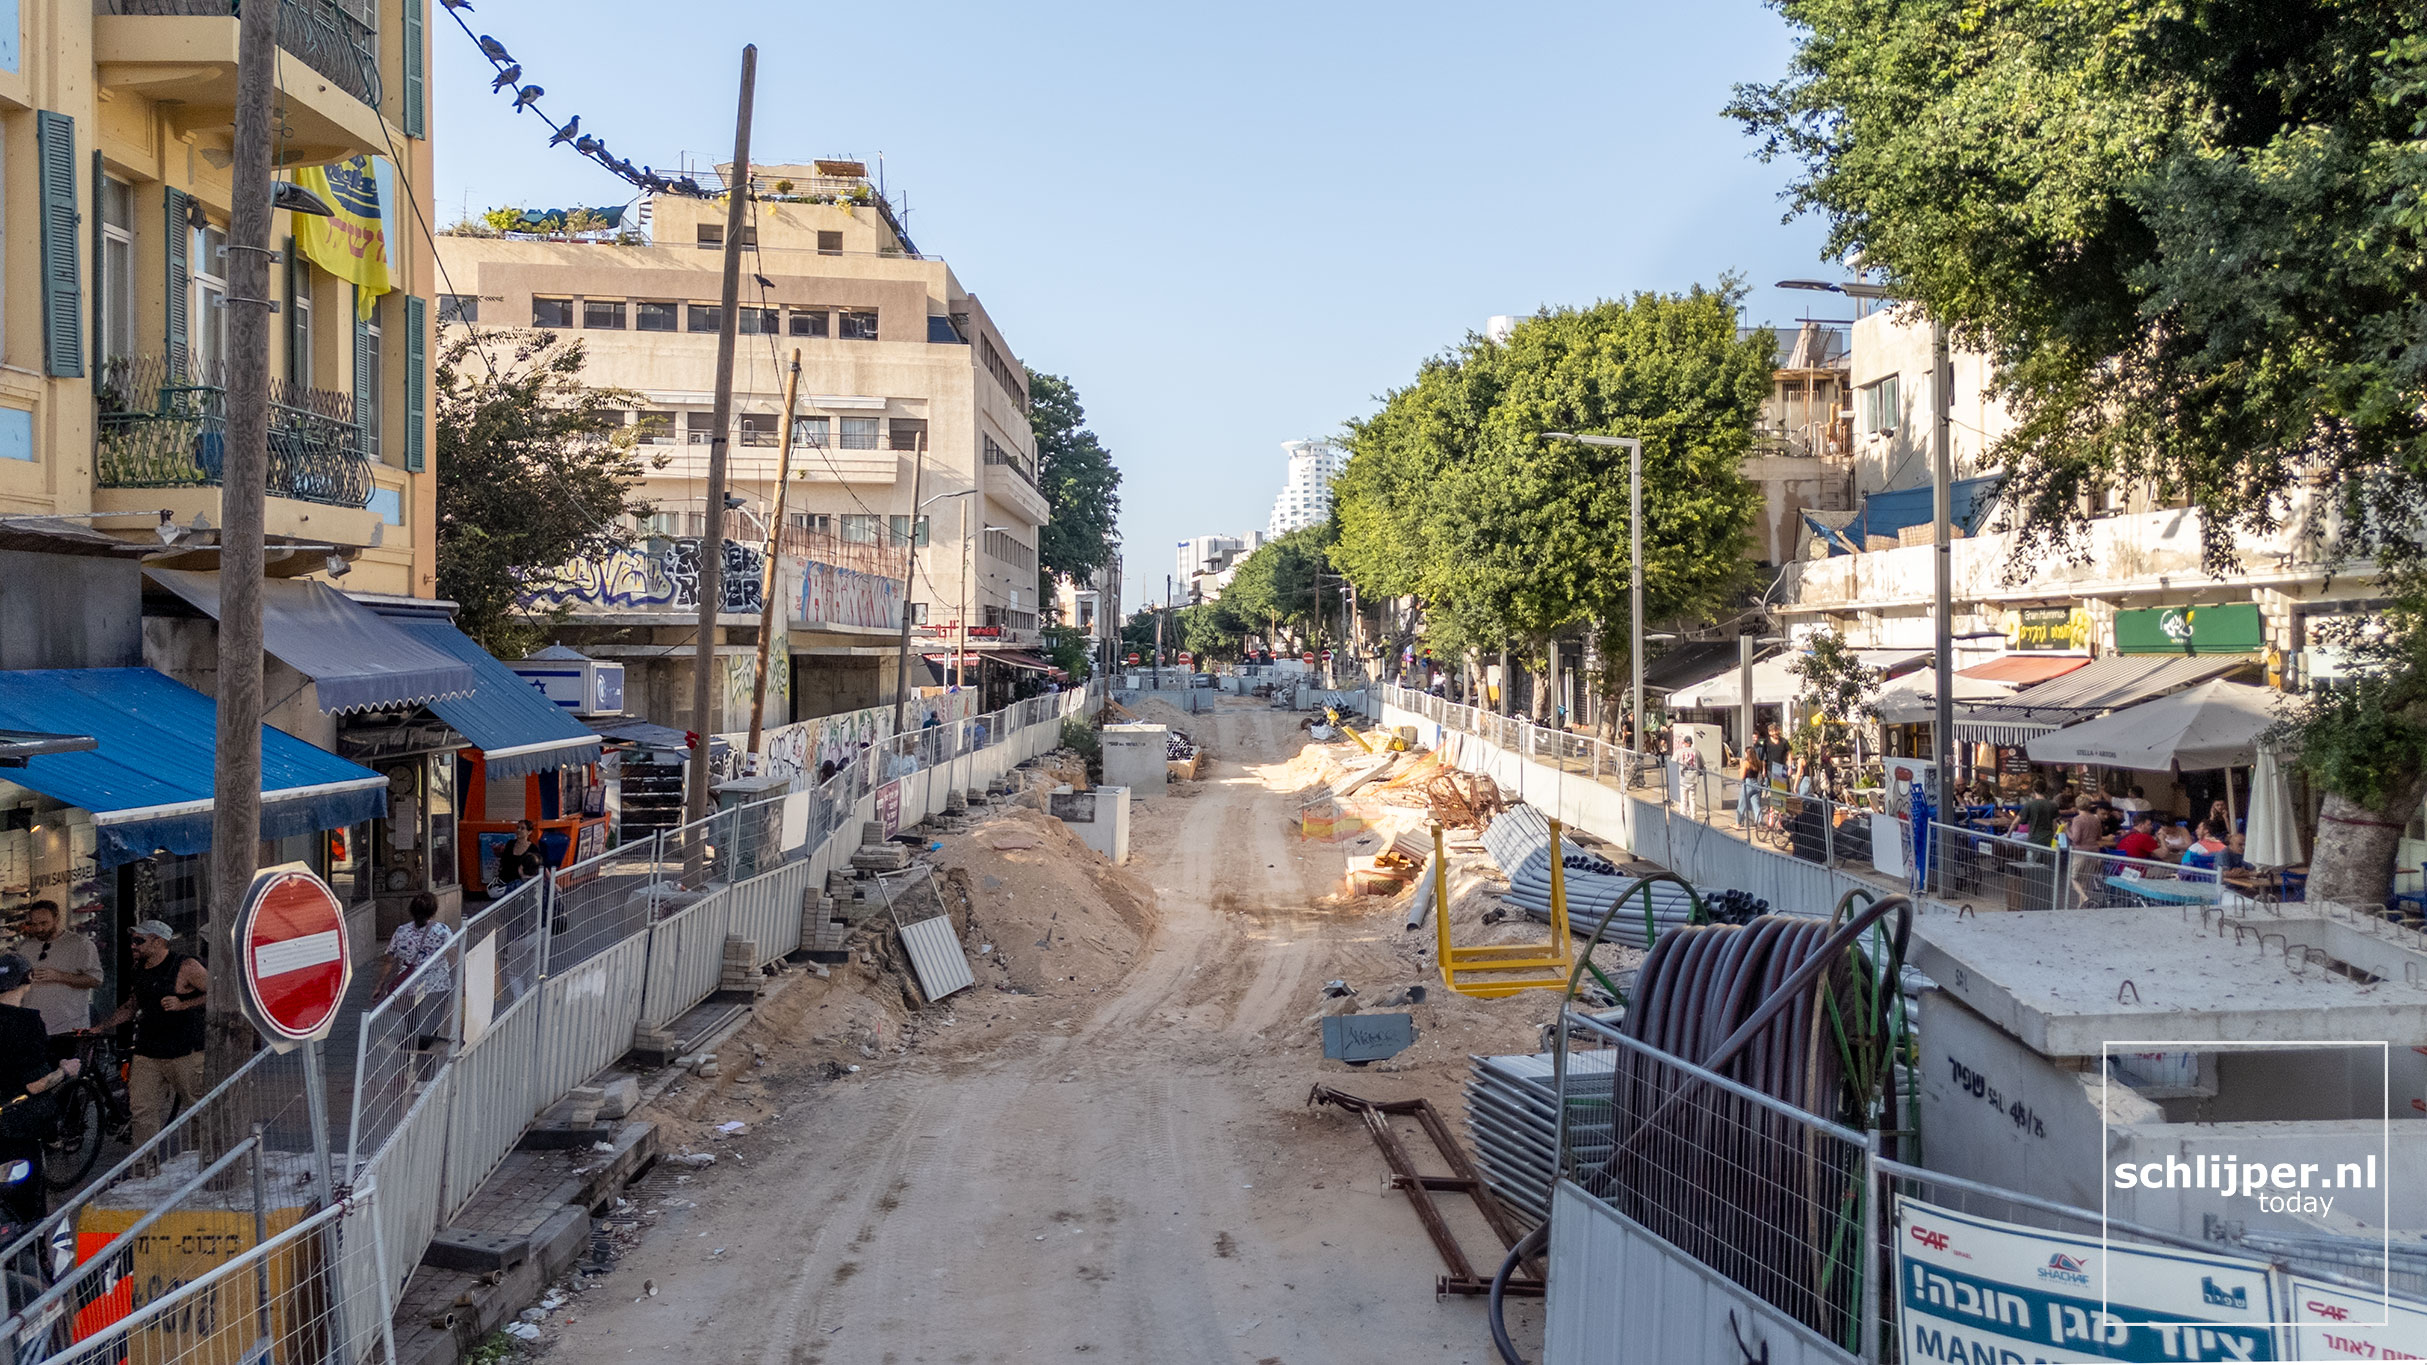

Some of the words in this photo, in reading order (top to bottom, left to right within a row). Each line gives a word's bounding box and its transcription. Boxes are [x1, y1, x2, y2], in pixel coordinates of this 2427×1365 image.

[1910, 1225, 1949, 1251] CAF
[2037, 1267, 2089, 1285] SHACHAF
[1913, 1264, 2031, 1328] חובה!
[2204, 1293, 2245, 1308] שפיר
[2306, 1300, 2350, 1321] CAF
[2048, 1302, 2128, 1346] מגן
[2148, 1320, 2254, 1361] ציוד
[2322, 1333, 2376, 1358] לאתר
